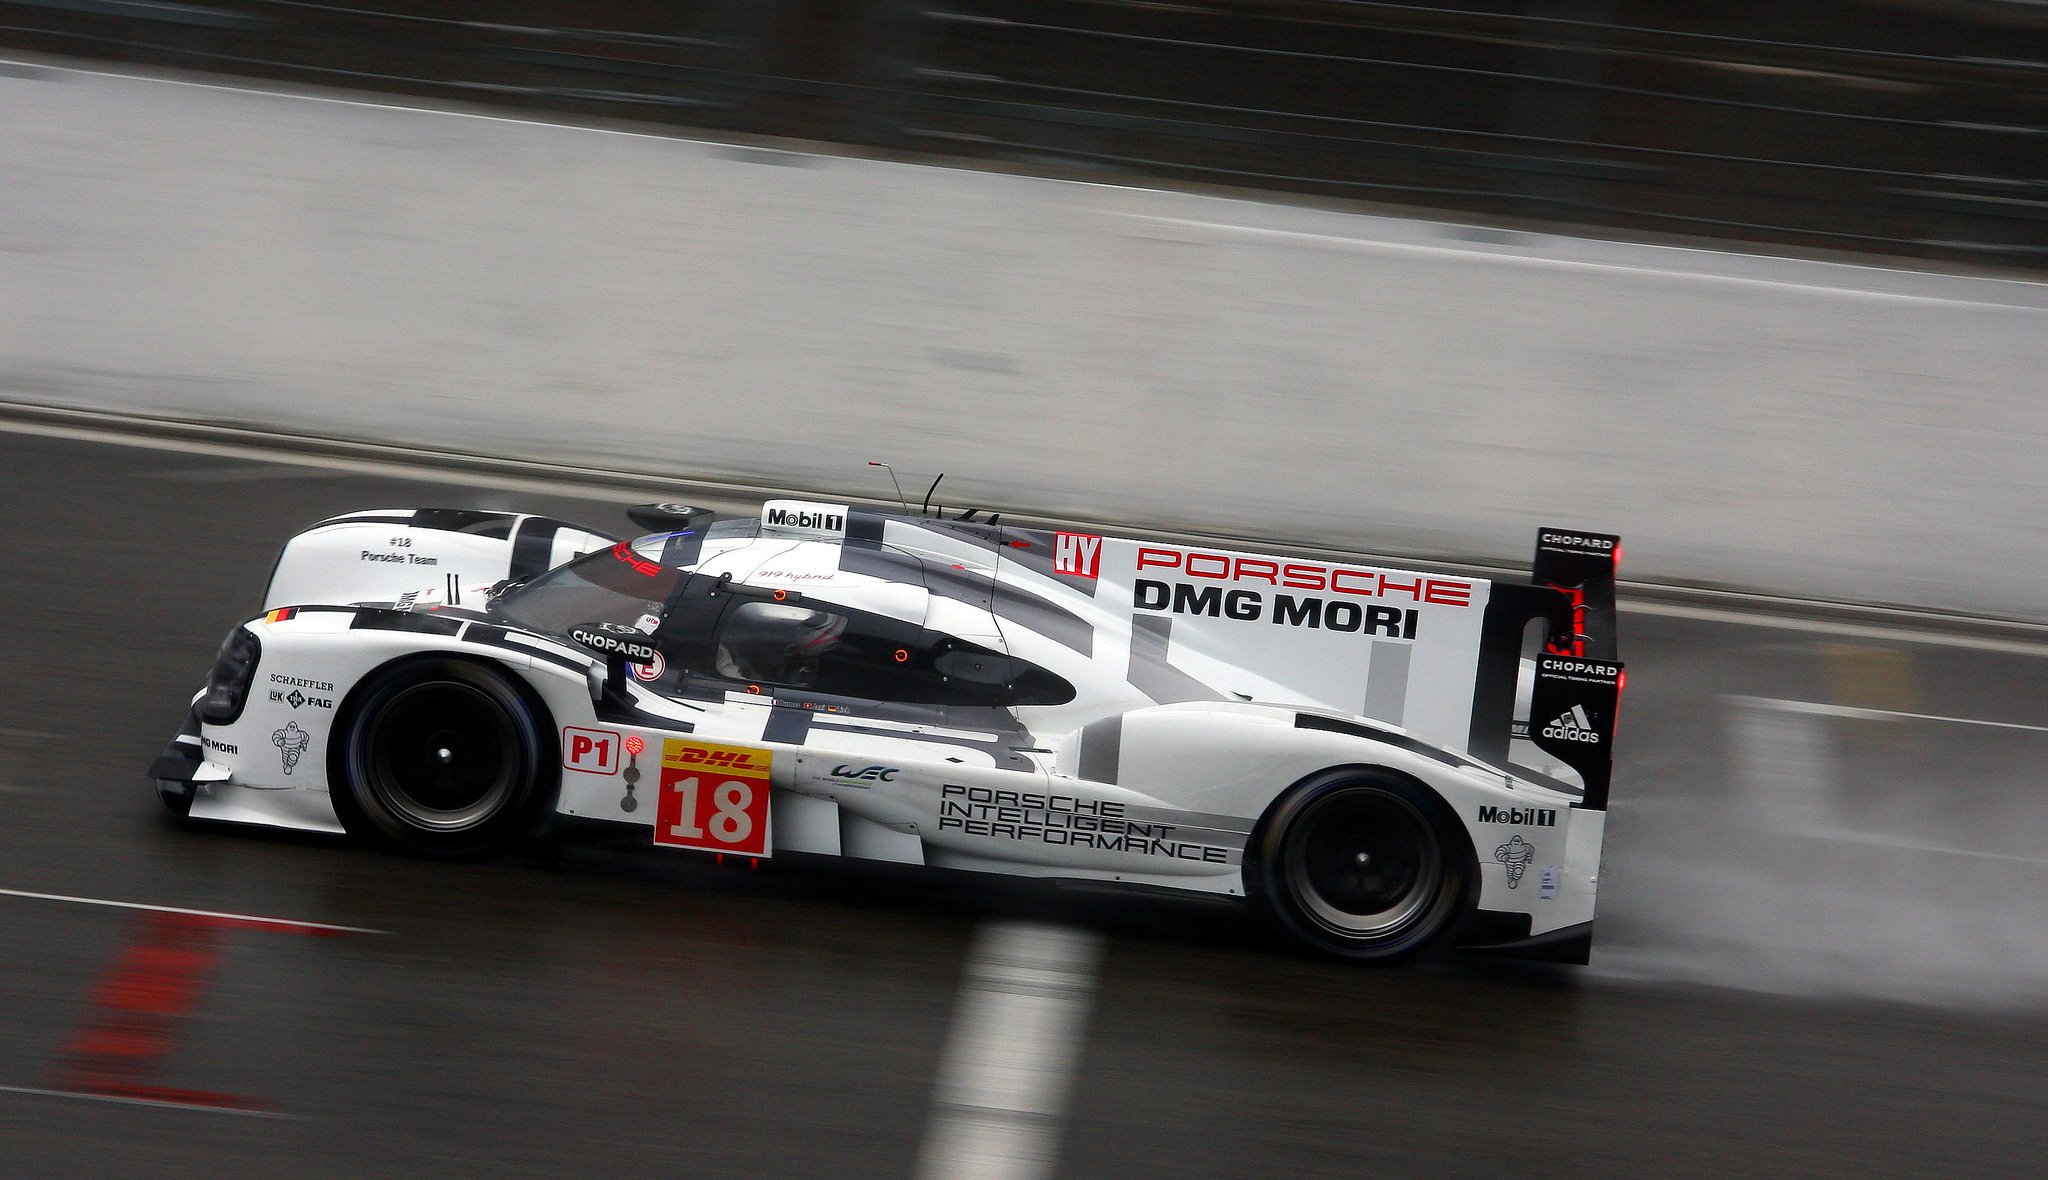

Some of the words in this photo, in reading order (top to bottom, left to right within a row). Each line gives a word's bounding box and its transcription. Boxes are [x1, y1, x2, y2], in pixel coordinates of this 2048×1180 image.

[768, 508, 823, 529] Mobil
[389, 537, 412, 548] #18
[1541, 533, 1614, 549] CHOPARD
[361, 550, 405, 564] Porsche
[407, 553, 438, 566] Team
[1055, 534, 1101, 575] HY
[1136, 547, 1472, 607] PORSCHE
[1133, 578, 1262, 621] DMG
[1272, 594, 1419, 640] MORI
[572, 629, 654, 659] CHOPARD
[1542, 659, 1618, 676] CHOPARD
[269, 673, 334, 692] SCHAEFFLER
[307, 696, 333, 709] FAG
[1542, 725, 1600, 743] adidas
[211, 740, 238, 755] MORI
[571, 734, 610, 767] P1
[678, 747, 753, 769] DHL
[830, 764, 900, 782] WEC
[669, 776, 753, 843] 18
[941, 784, 1125, 818] PORSCHE
[940, 800, 1176, 840] INTELLIGENT
[1478, 805, 1535, 825] Mobil
[938, 816, 1228, 864] PERFORMANCE
